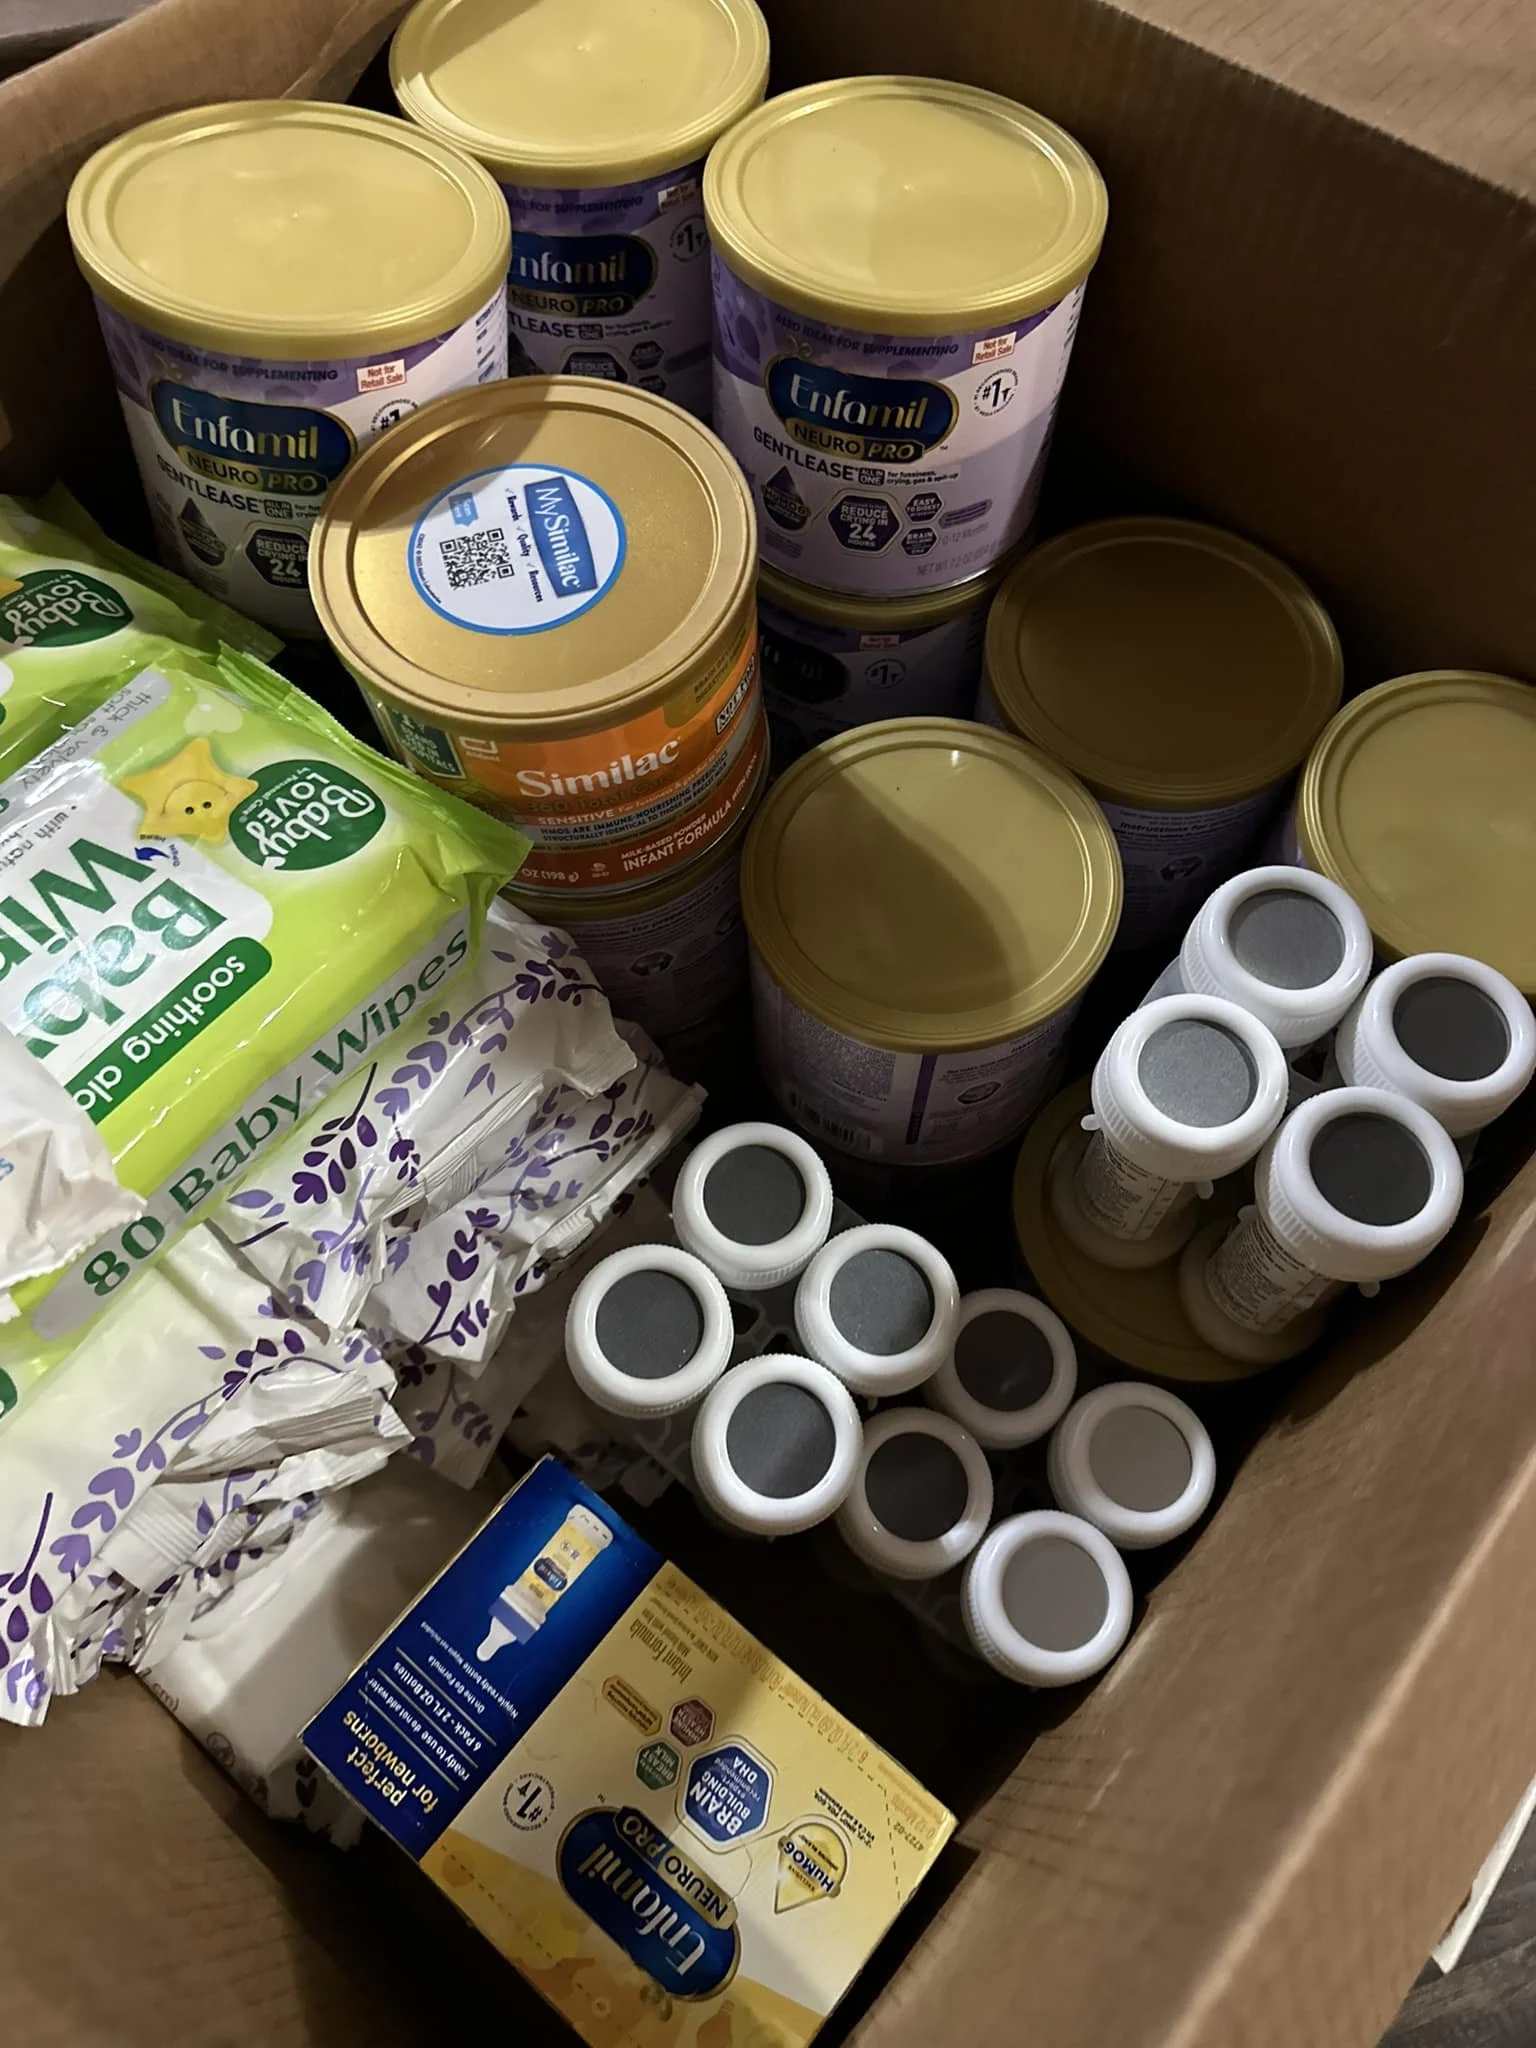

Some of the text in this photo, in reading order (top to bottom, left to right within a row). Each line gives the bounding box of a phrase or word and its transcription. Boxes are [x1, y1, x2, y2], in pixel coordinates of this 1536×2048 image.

[515, 249, 627, 284] nfamil
[581, 296, 626, 314] PRO
[803, 327, 835, 346] IDEAL
[837, 338, 860, 350] FOR
[863, 342, 960, 357] SUPPLEMENTING
[975, 345, 1012, 361] Retail Sale
[983, 338, 1009, 351] Not for
[203, 358, 338, 381] FOR SUPPLEMENTING
[361, 373, 404, 389] Retail Sale
[366, 364, 396, 378] Not for
[791, 374, 928, 430] Enfamil
[172, 398, 319, 459] Enfamil
[794, 423, 915, 460] NEURO PRO
[753, 426, 854, 481] GENTLEASE
[157, 453, 261, 513] GENTLEASE
[188, 454, 318, 491] NEURO PRO
[267, 508, 292, 518] ONE
[841, 504, 889, 519] REDUCE
[535, 486, 580, 588] MySimilac
[849, 523, 877, 542] 24
[507, 495, 544, 603] Rewards Quality Resources
[270, 558, 301, 577] 24
[5, 591, 125, 635] Baby
[17, 580, 88, 615] LOVE
[108, 691, 152, 723] thick
[516, 739, 680, 798] Similac
[257, 772, 330, 829] LOVE
[34, 812, 69, 839] with
[246, 783, 376, 857] Baby
[537, 810, 616, 826] SENSITIVE
[571, 823, 591, 836] ARE
[621, 832, 674, 860] MILK-BASED
[673, 812, 708, 838] POWDER
[623, 846, 674, 871] INFANT
[677, 800, 732, 852] FORMULA
[24, 878, 228, 1060] Bab
[122, 955, 246, 1064] soothing
[83, 927, 469, 1297] 80 Baby Wipes
[628, 1618, 668, 1661] Formula
[393, 1662, 423, 1695] Bottles
[427, 1655, 456, 1687] Formula
[462, 1661, 485, 1685] bottle
[662, 1653, 694, 1685] Infant
[419, 1691, 435, 1706] OZ
[461, 1692, 475, 1706] the
[482, 1679, 502, 1699] ready
[433, 1702, 446, 1717] FL
[442, 1711, 453, 1722] 2
[473, 1702, 486, 1715] On
[367, 1677, 471, 1783] ready to use do not add water
[452, 1721, 476, 1748] Pack
[343, 1710, 440, 1815] for newborns
[472, 1742, 482, 1752] 6
[656, 1744, 676, 1767] MILK
[346, 1746, 408, 1808] perfect
[642, 1749, 675, 1781] BREAST
[732, 1755, 758, 1782] DHA
[690, 1780, 743, 1836] BRAIN
[701, 1771, 751, 1818] BUILDING
[621, 1815, 729, 1922] NEURO PRO
[784, 1839, 836, 1893] HuMO6
[577, 1841, 707, 1977] Enfamil
